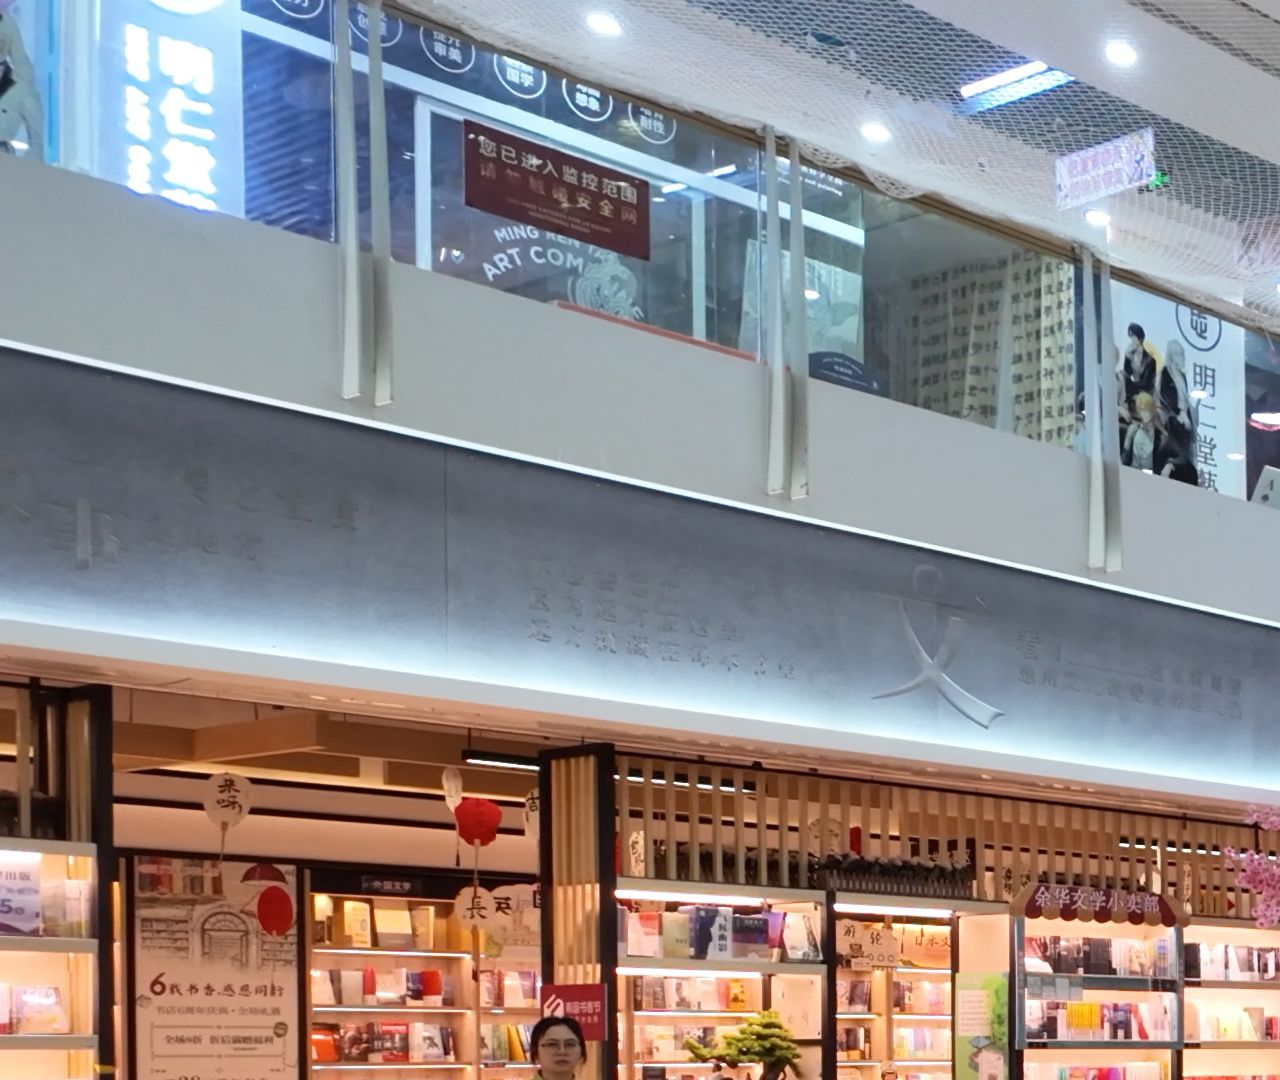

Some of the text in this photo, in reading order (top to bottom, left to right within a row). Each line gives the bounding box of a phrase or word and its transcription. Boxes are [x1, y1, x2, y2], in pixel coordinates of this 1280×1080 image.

[506, 67, 535, 88] 国学
[478, 135, 638, 206] 您已进入监控范围
[493, 225, 540, 244] MING
[481, 246, 524, 282] ART
[1034, 886, 1160, 914] 余华文学小卖部
